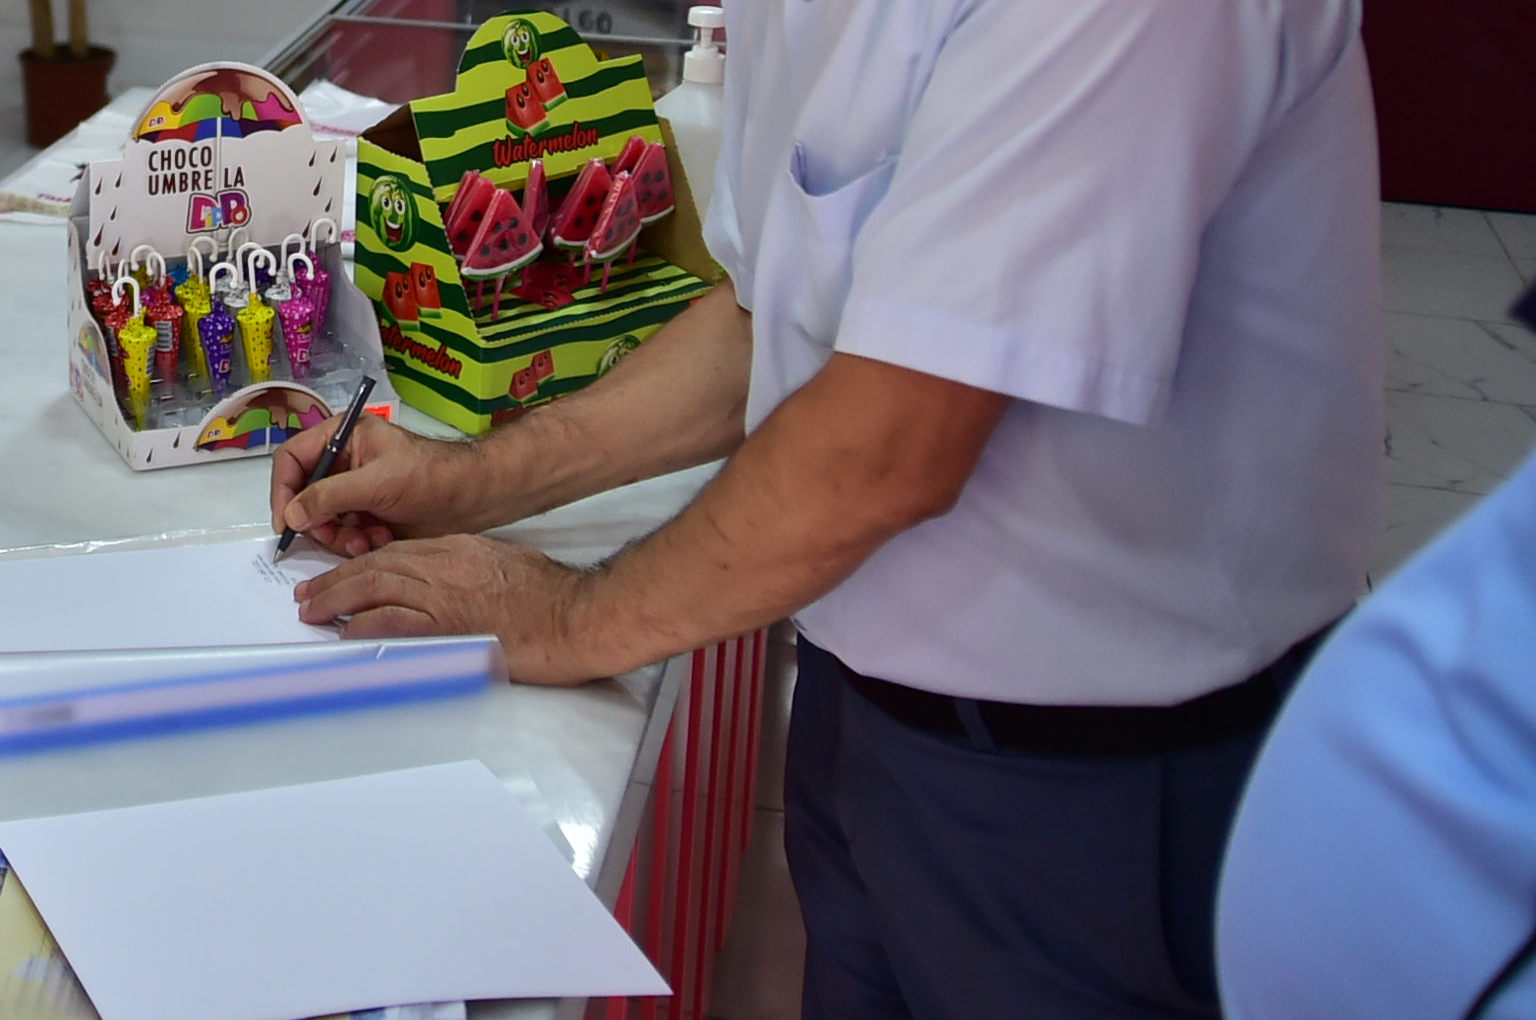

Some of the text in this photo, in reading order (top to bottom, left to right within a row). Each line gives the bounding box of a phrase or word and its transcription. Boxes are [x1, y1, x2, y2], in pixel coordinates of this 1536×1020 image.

[148, 144, 212, 172] CHOCO
[493, 122, 599, 168] Watermelon
[148, 166, 245, 196] UMBRE LA
[380, 322, 462, 380] atermelon
